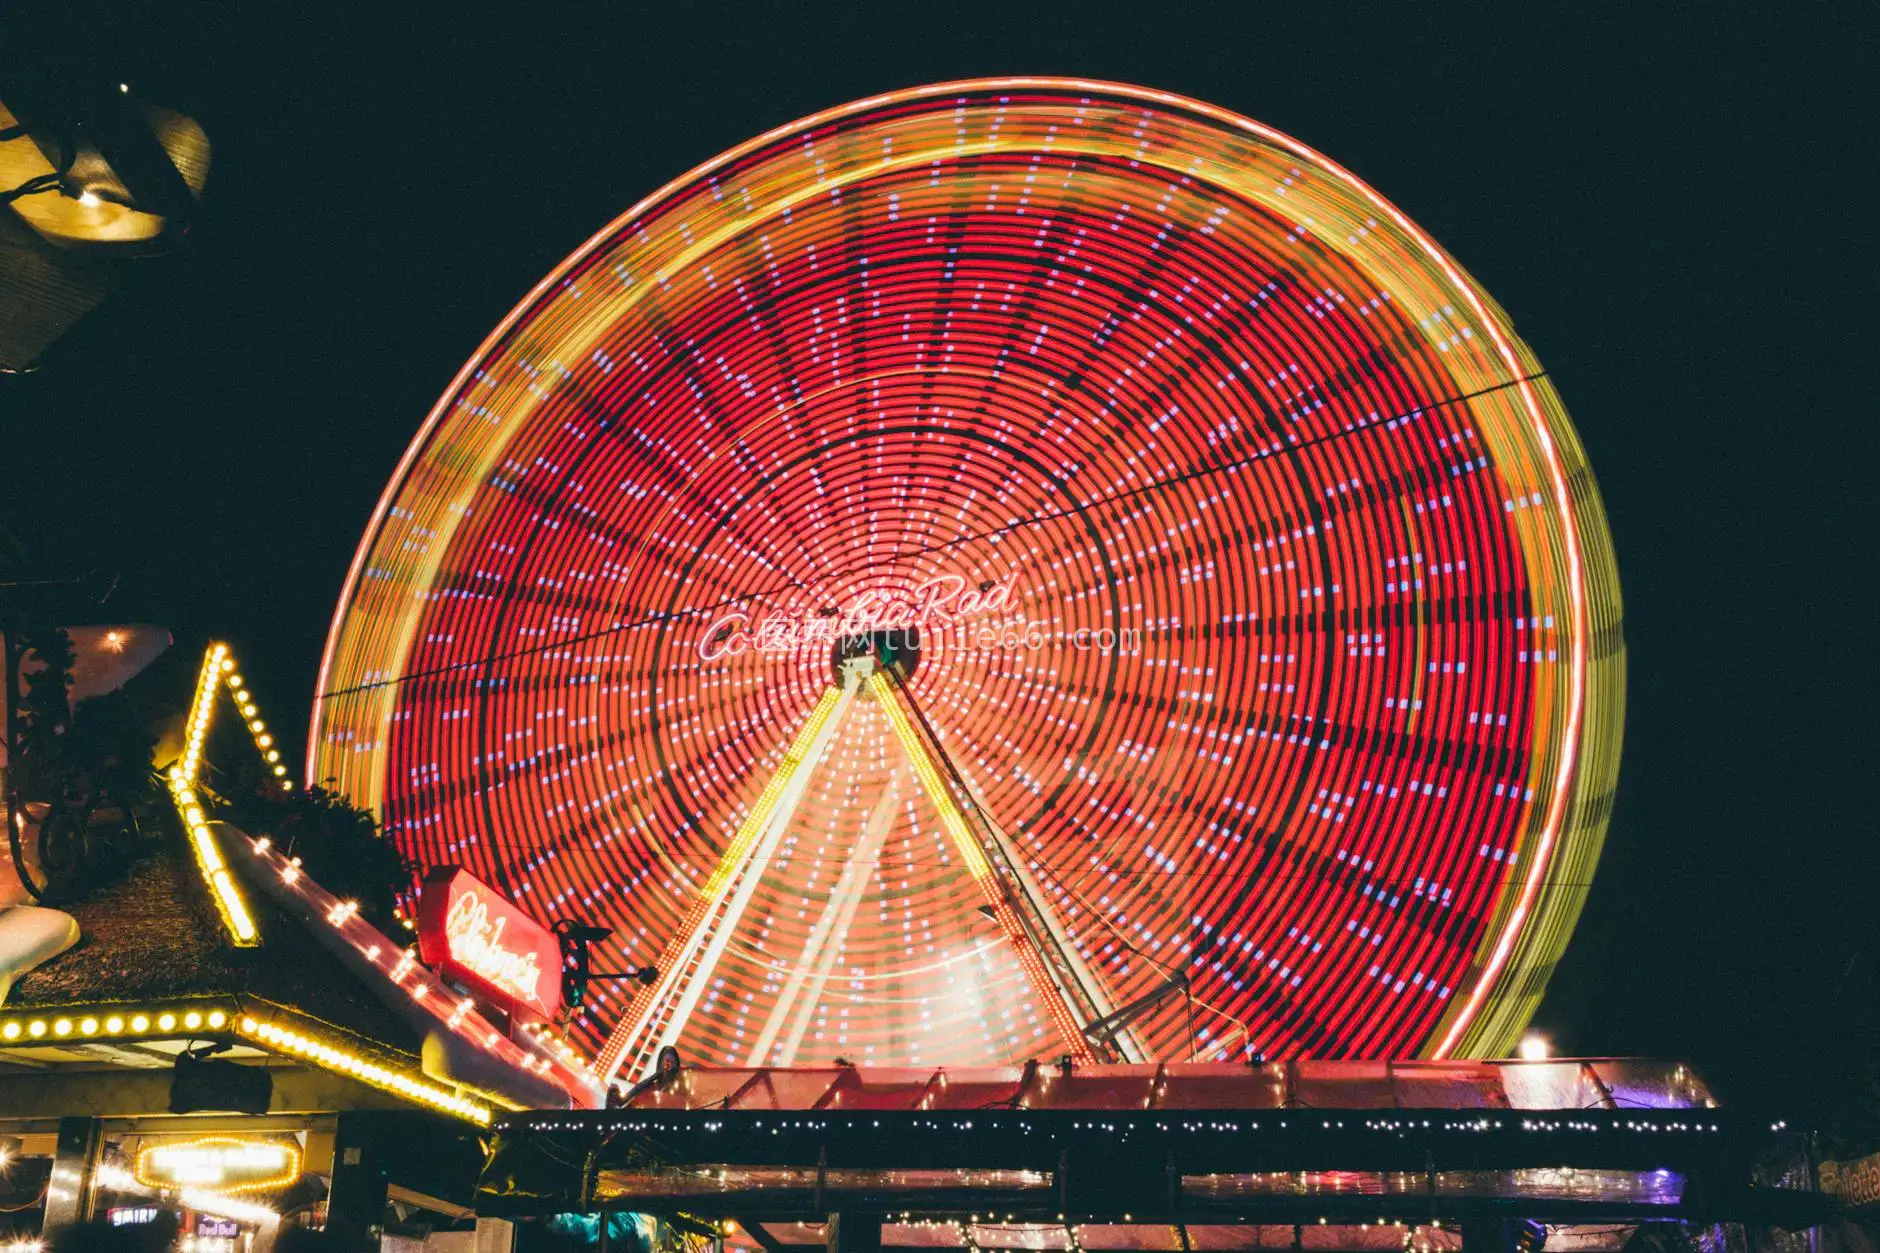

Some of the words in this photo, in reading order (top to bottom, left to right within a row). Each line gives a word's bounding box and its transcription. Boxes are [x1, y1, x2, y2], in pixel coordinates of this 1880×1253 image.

[916, 570, 1022, 622] Rad
[199, 1223, 217, 1236] Red
[219, 1223, 237, 1236] Bull
